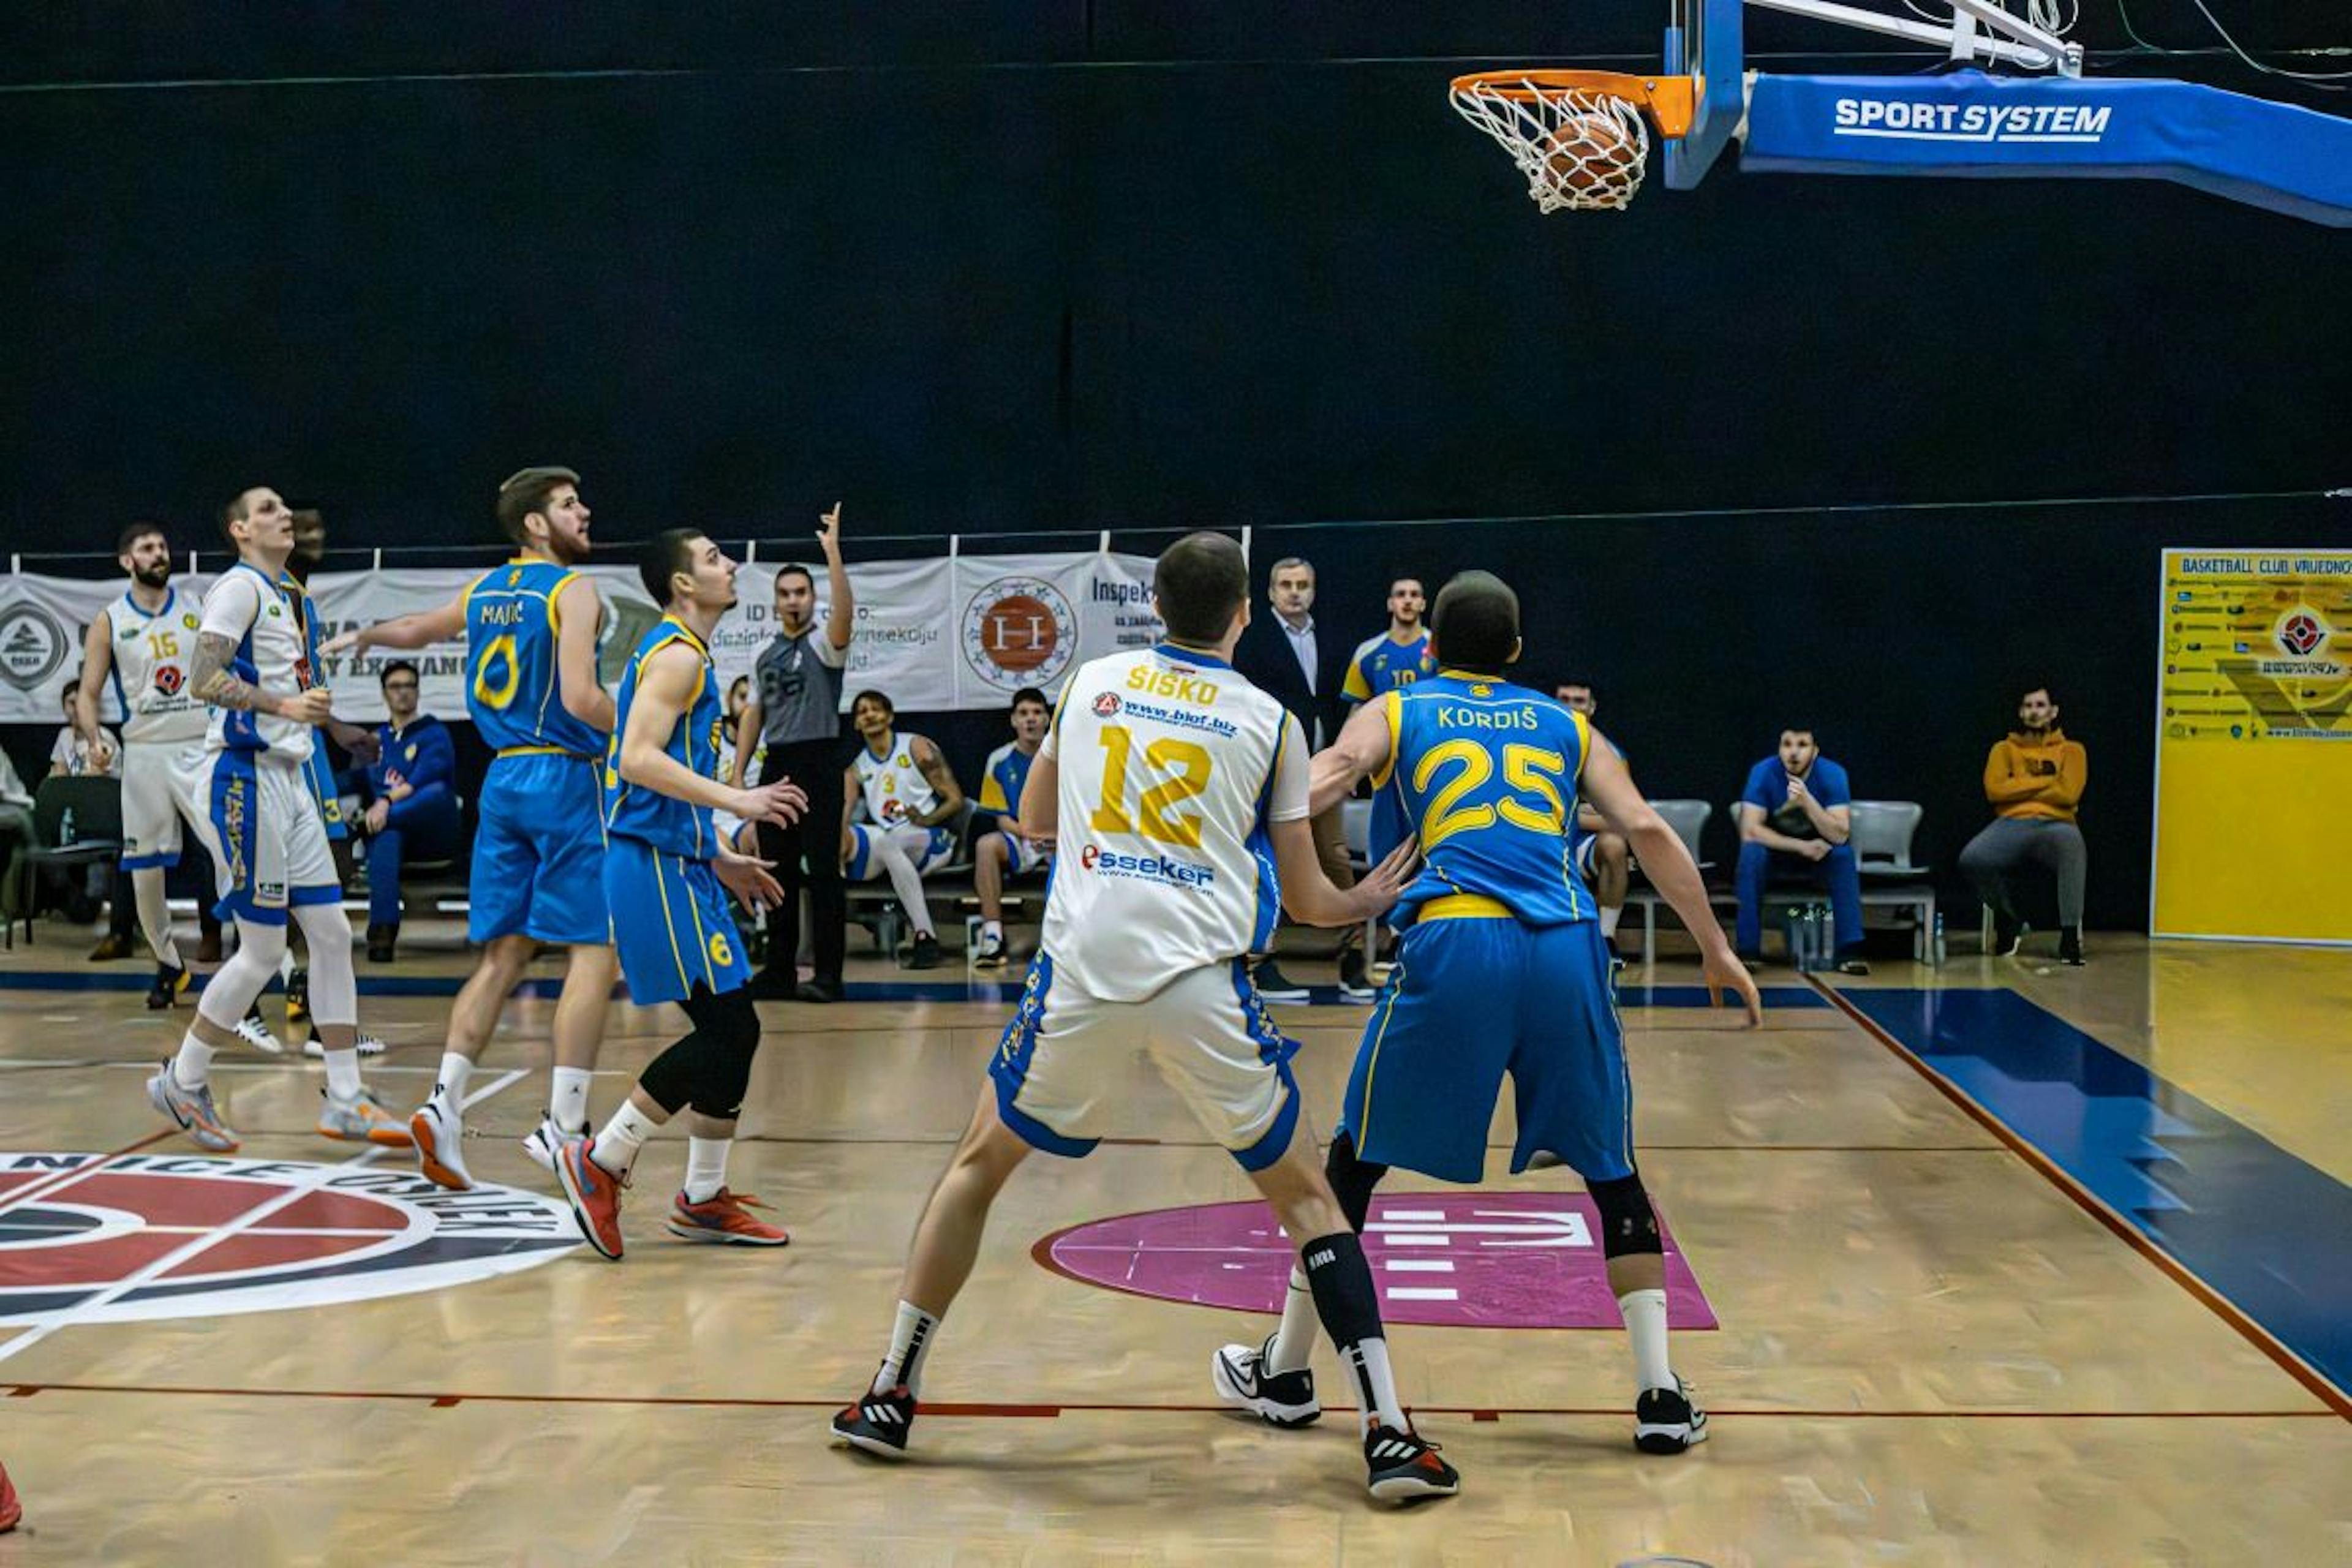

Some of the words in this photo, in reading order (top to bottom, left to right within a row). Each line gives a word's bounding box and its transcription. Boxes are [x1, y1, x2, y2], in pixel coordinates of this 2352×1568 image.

[1835, 99, 1959, 130] SPORT
[1960, 105, 2112, 141] SYSTEM
[2182, 558, 2253, 573] BASKETBALL
[2259, 559, 2289, 574] CLUB
[1093, 576, 1153, 606] Inspek
[746, 604, 766, 621] ID
[148, 631, 178, 660] 15
[1438, 706, 1538, 731] KORDIŠ
[1089, 724, 1213, 849] 12
[1412, 739, 1566, 856] 25
[1082, 844, 1215, 886] esseker
